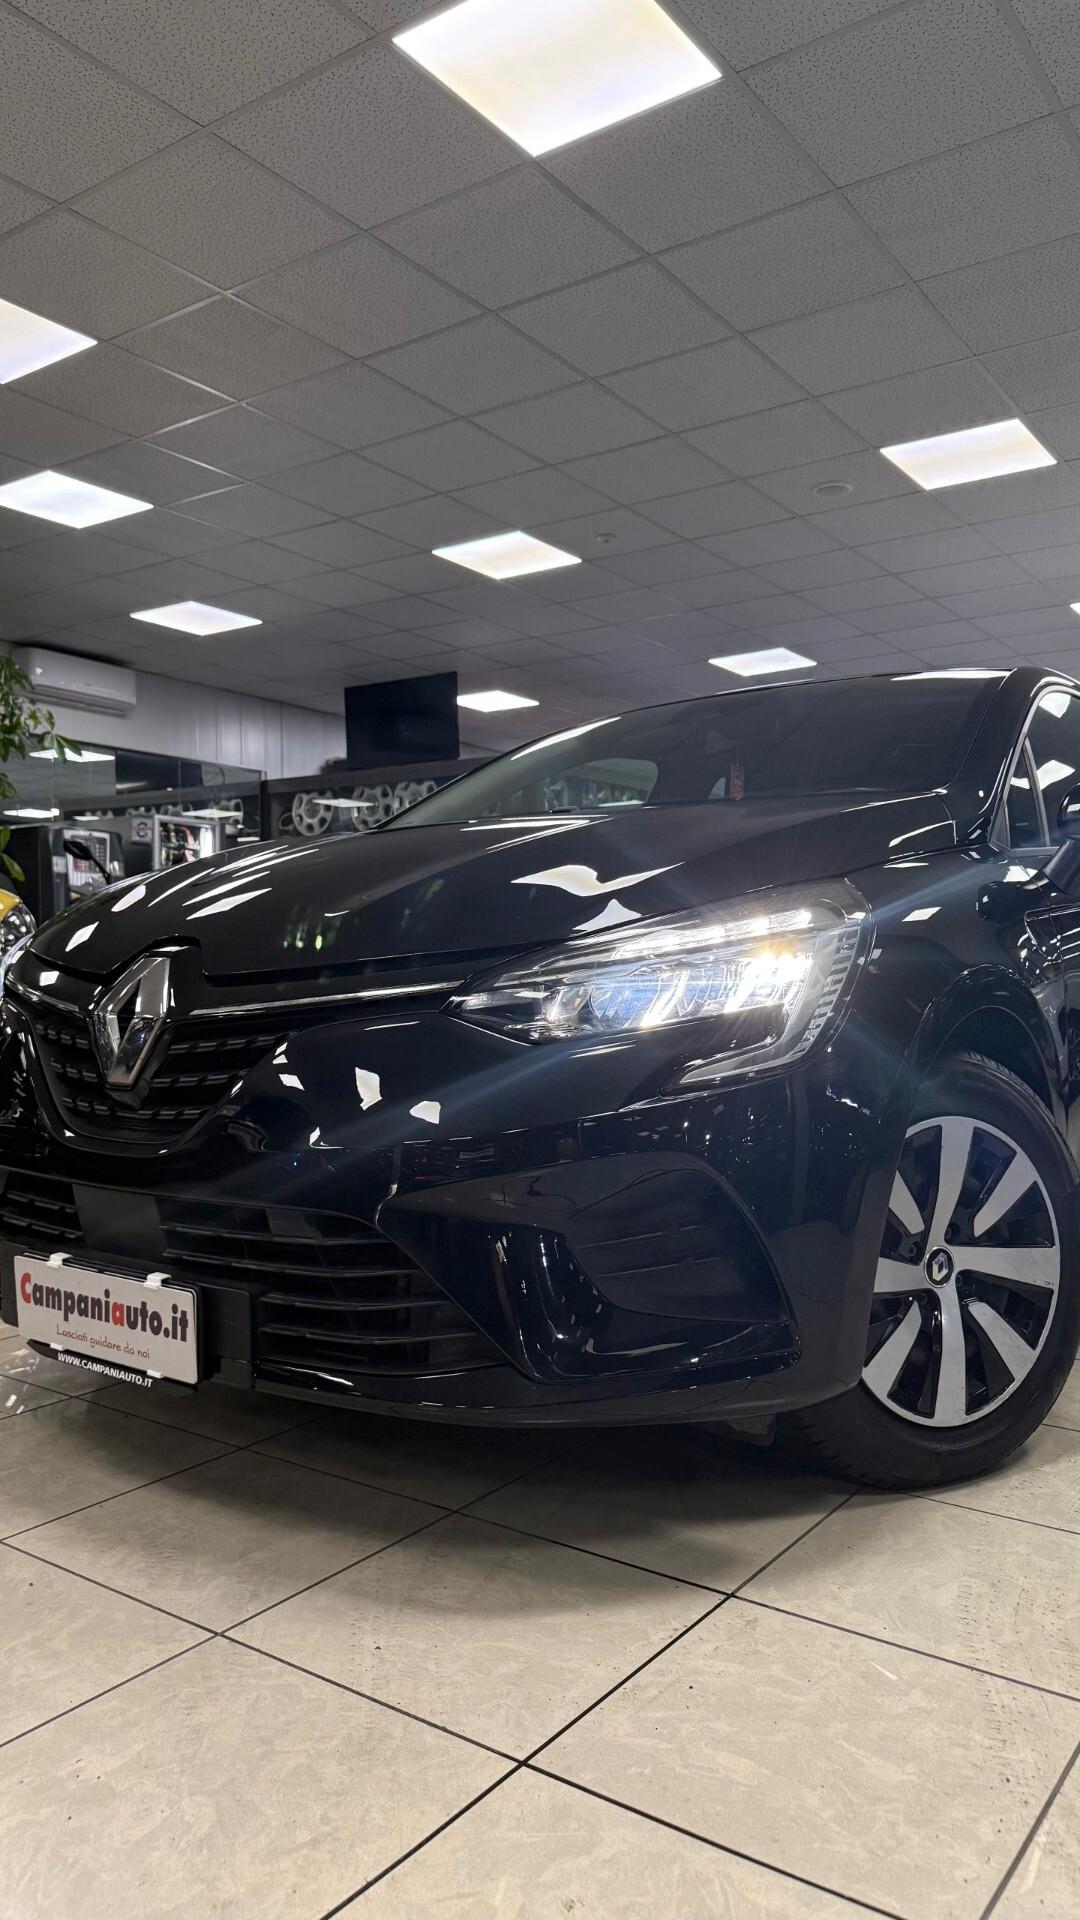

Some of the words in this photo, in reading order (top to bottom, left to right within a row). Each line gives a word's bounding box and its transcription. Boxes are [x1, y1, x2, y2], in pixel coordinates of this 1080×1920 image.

[20, 1272, 189, 1342] Campaniauto.it
[56, 1323, 88, 1342] Lasciati
[89, 1335, 122, 1352] guidare
[124, 1341, 135, 1355] da
[137, 1348, 150, 1359] noi
[57, 1352, 153, 1388] WWW.CAMPANIAUTO.IT
